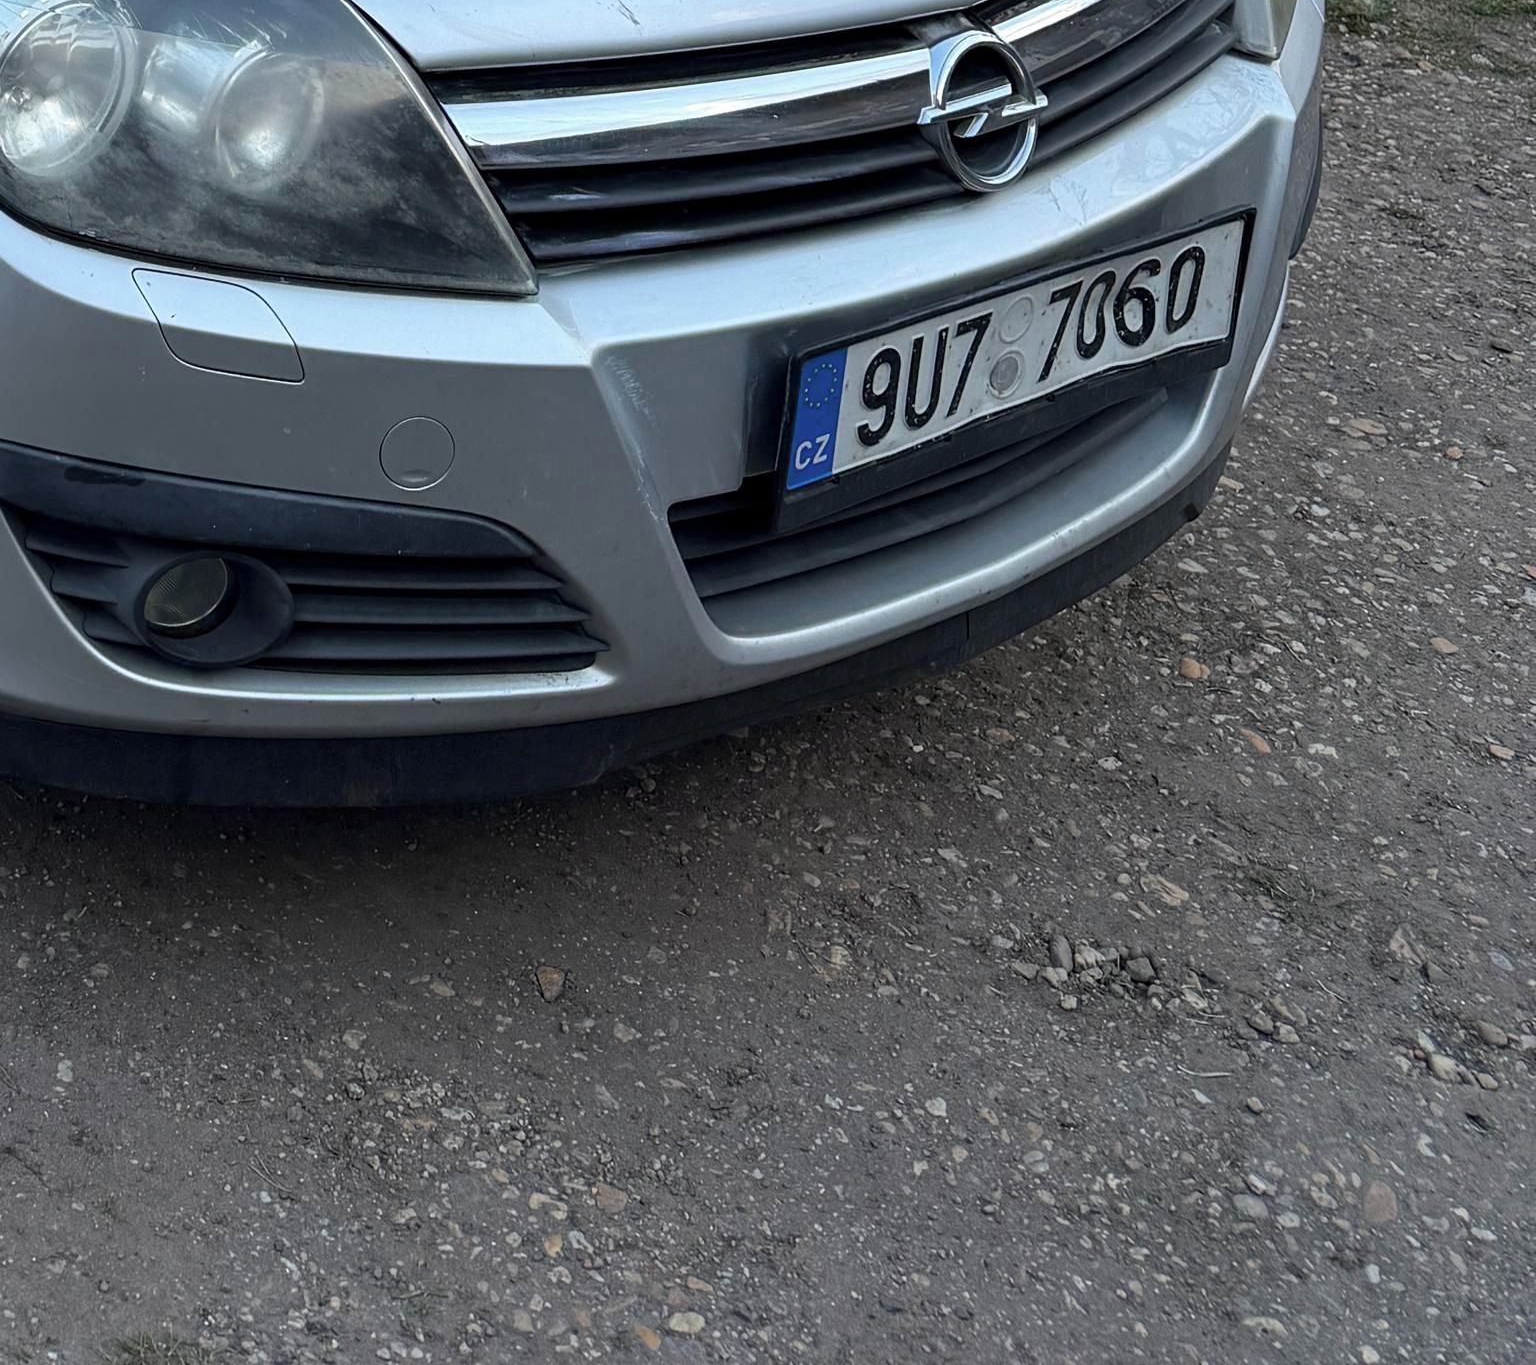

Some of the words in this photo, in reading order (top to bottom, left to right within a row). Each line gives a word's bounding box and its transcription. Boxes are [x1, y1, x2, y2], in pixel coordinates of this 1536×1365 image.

[856, 312, 993, 446] 9U7
[1038, 245, 1206, 383] 7060
[795, 434, 830, 470] CZ
